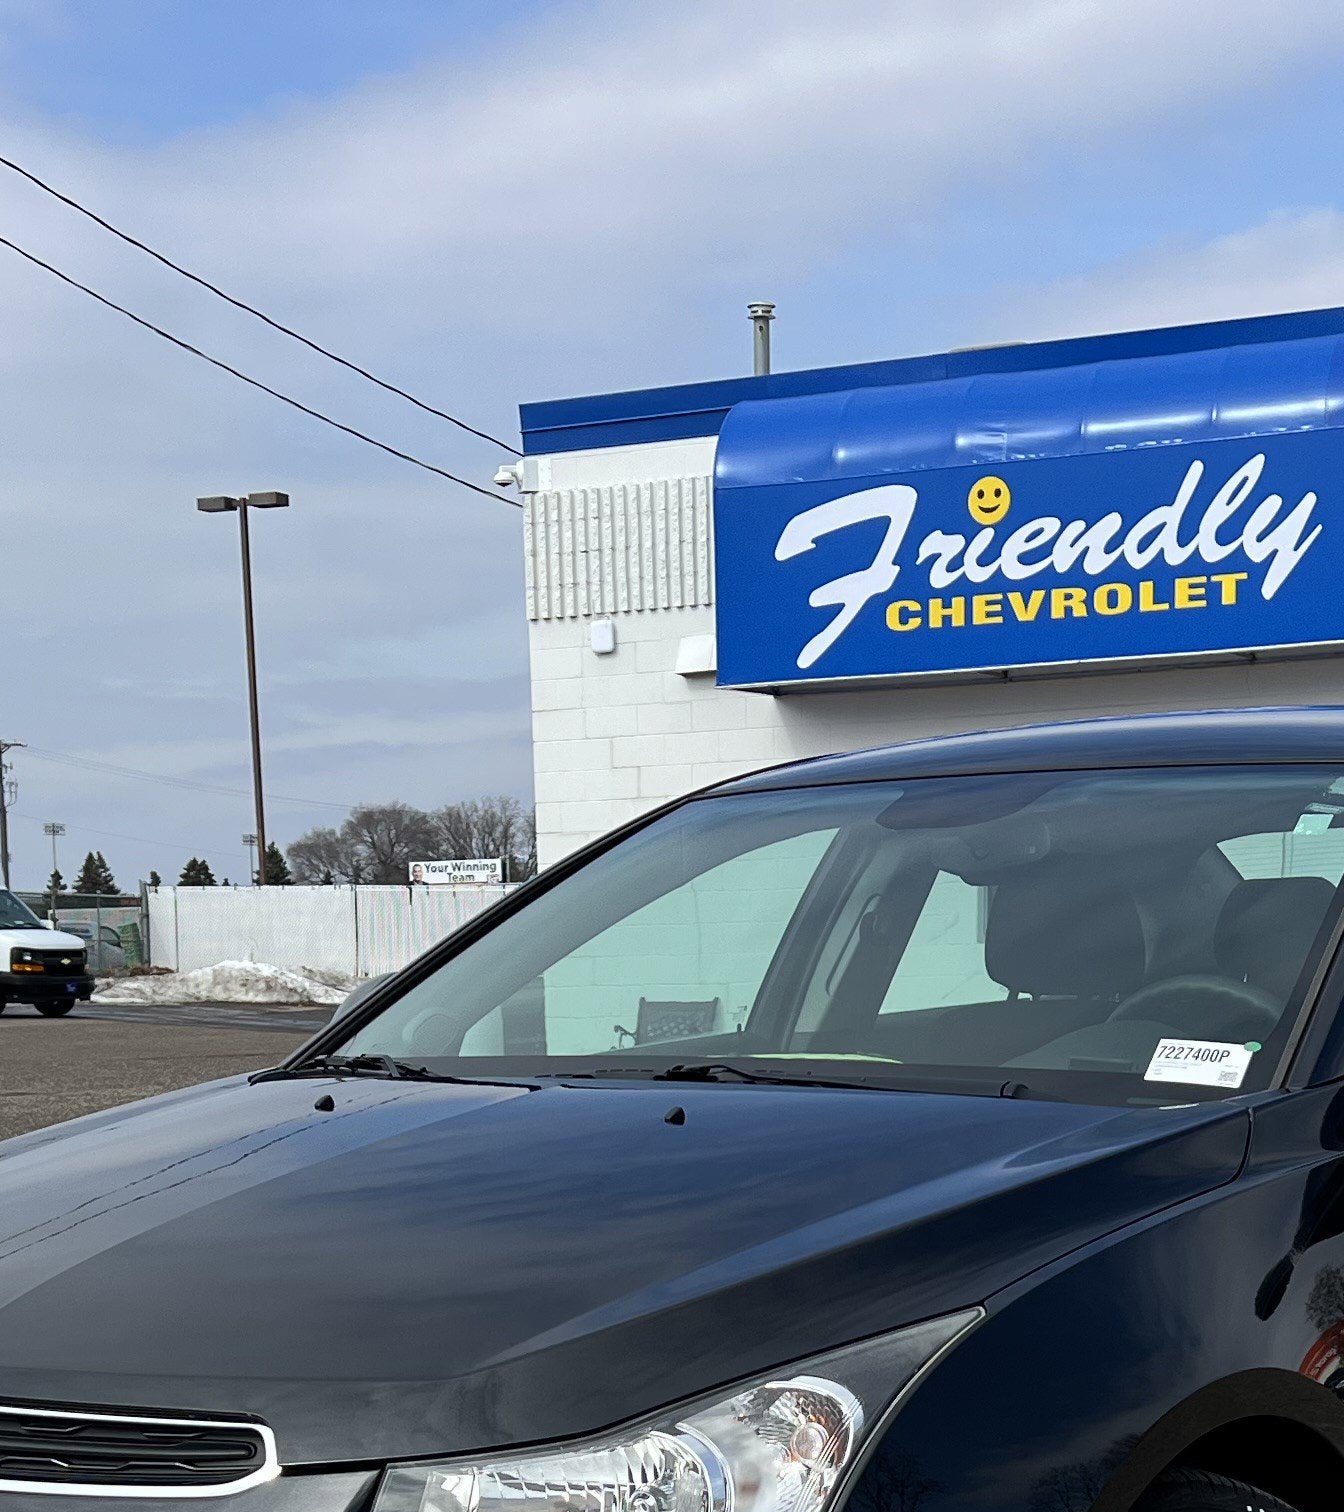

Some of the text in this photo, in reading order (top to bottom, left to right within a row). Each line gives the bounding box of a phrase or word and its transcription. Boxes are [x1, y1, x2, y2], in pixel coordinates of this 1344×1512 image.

[775, 453, 1323, 669] Friendly
[885, 573, 1248, 632] CHEVROLET
[424, 861, 497, 873] Your Winning
[446, 872, 475, 883] Team
